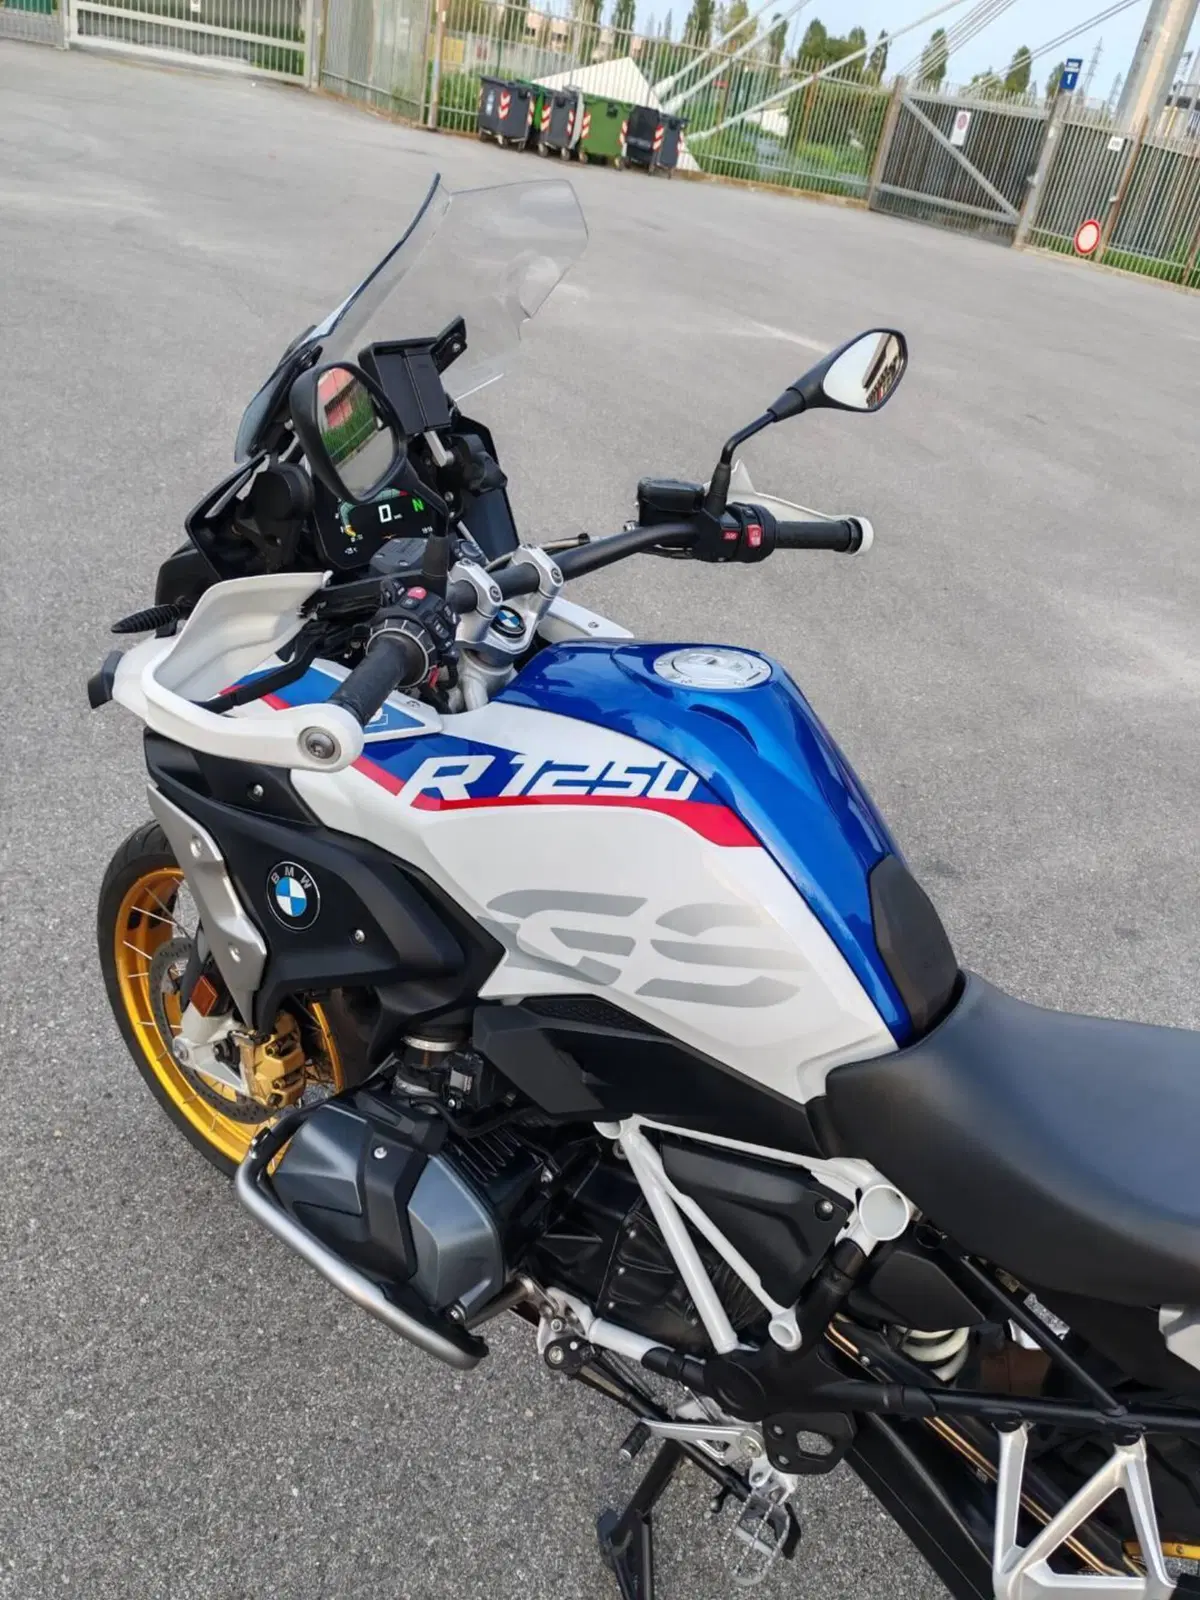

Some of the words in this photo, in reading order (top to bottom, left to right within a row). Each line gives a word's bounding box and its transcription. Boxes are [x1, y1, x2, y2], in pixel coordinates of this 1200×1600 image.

[412, 498, 424, 512] N
[403, 754, 496, 804] R
[498, 754, 700, 801] 1250
[271, 866, 312, 889] BMW
